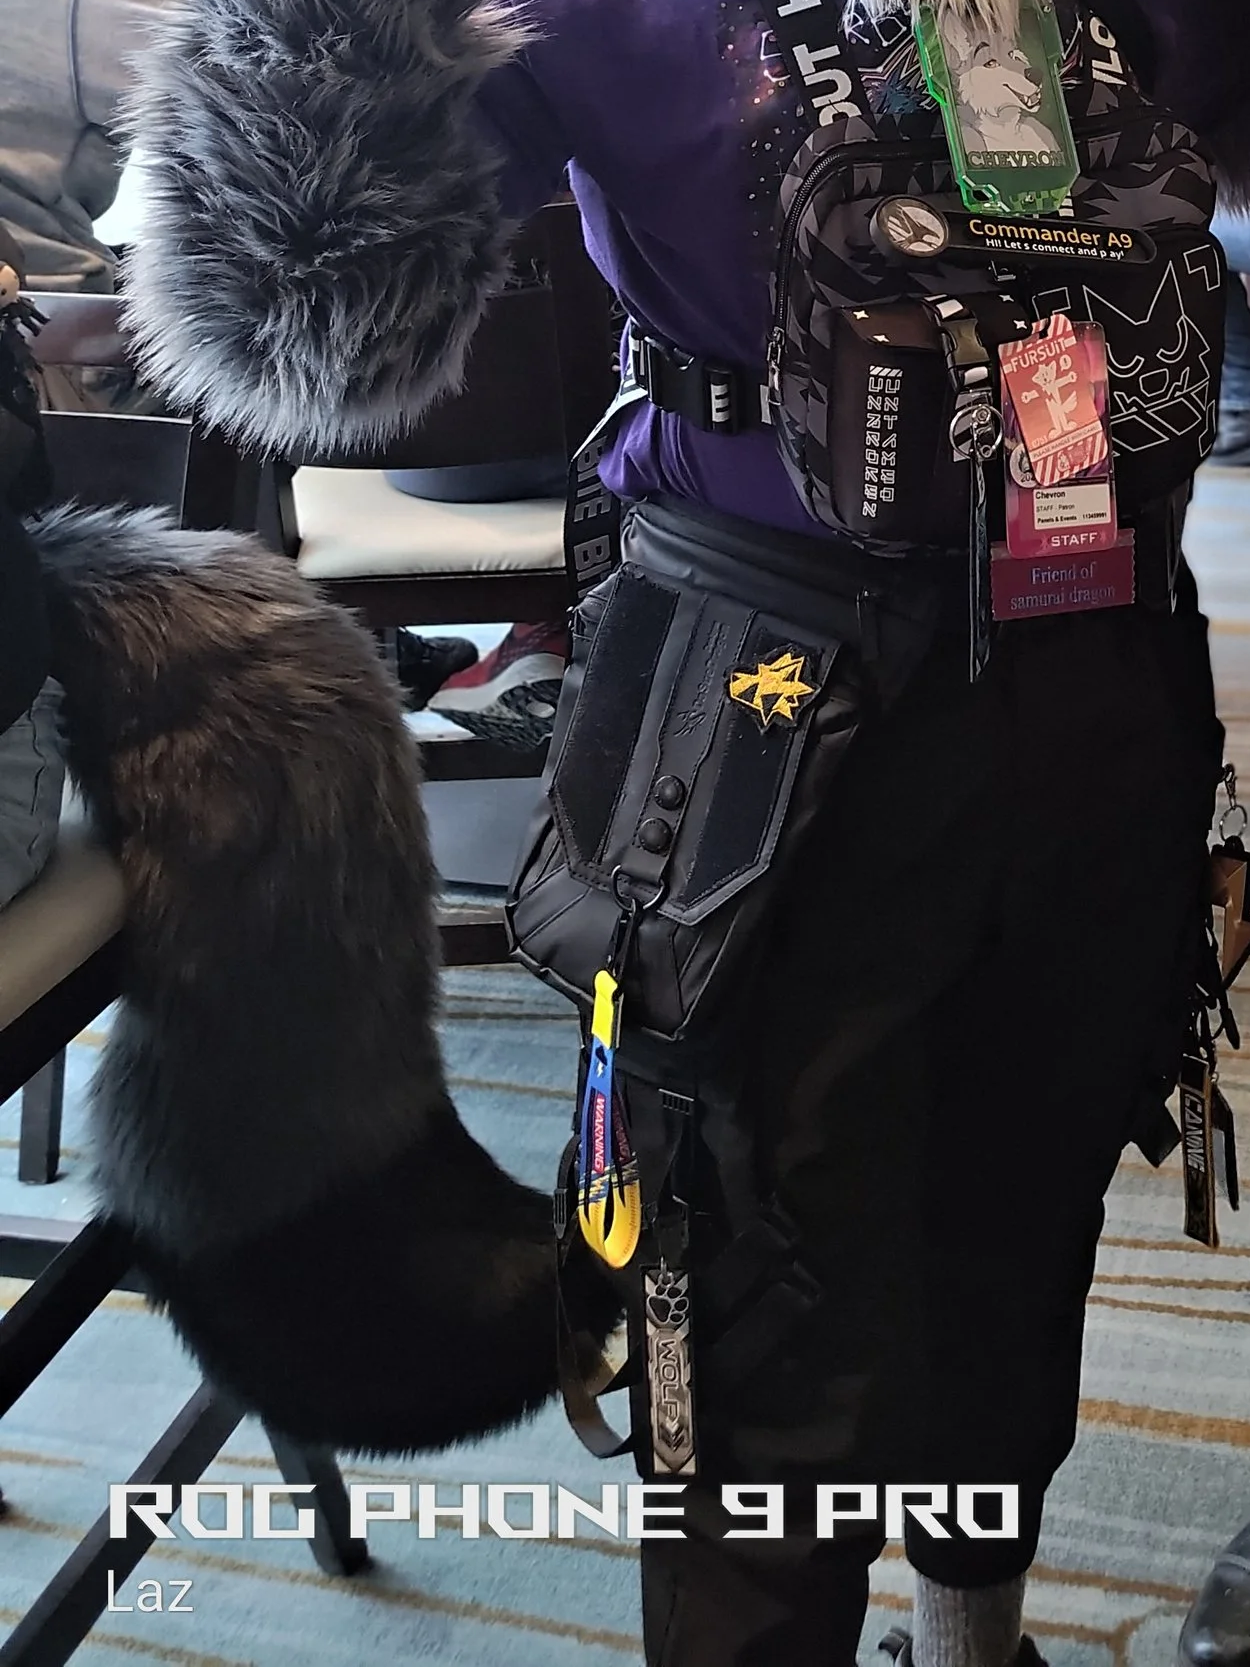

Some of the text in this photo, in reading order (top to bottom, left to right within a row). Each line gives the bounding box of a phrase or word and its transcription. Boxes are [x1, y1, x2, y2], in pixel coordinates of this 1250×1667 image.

[968, 150, 1066, 170] CHEVRON
[969, 219, 1134, 249] Commander A9
[1032, 241, 1076, 254] connect
[1077, 244, 1098, 256] and
[1035, 490, 1066, 500] Chevron
[1036, 505, 1054, 513] STAFF
[1060, 514, 1077, 522] Events
[1051, 532, 1098, 547] STAFF
[1032, 561, 1098, 584] Friend of
[1010, 585, 1116, 611] samurai dragon
[593, 1097, 606, 1171] WARNING
[1184, 1094, 1206, 1174] CANINE
[658, 1339, 681, 1421] WOLF
